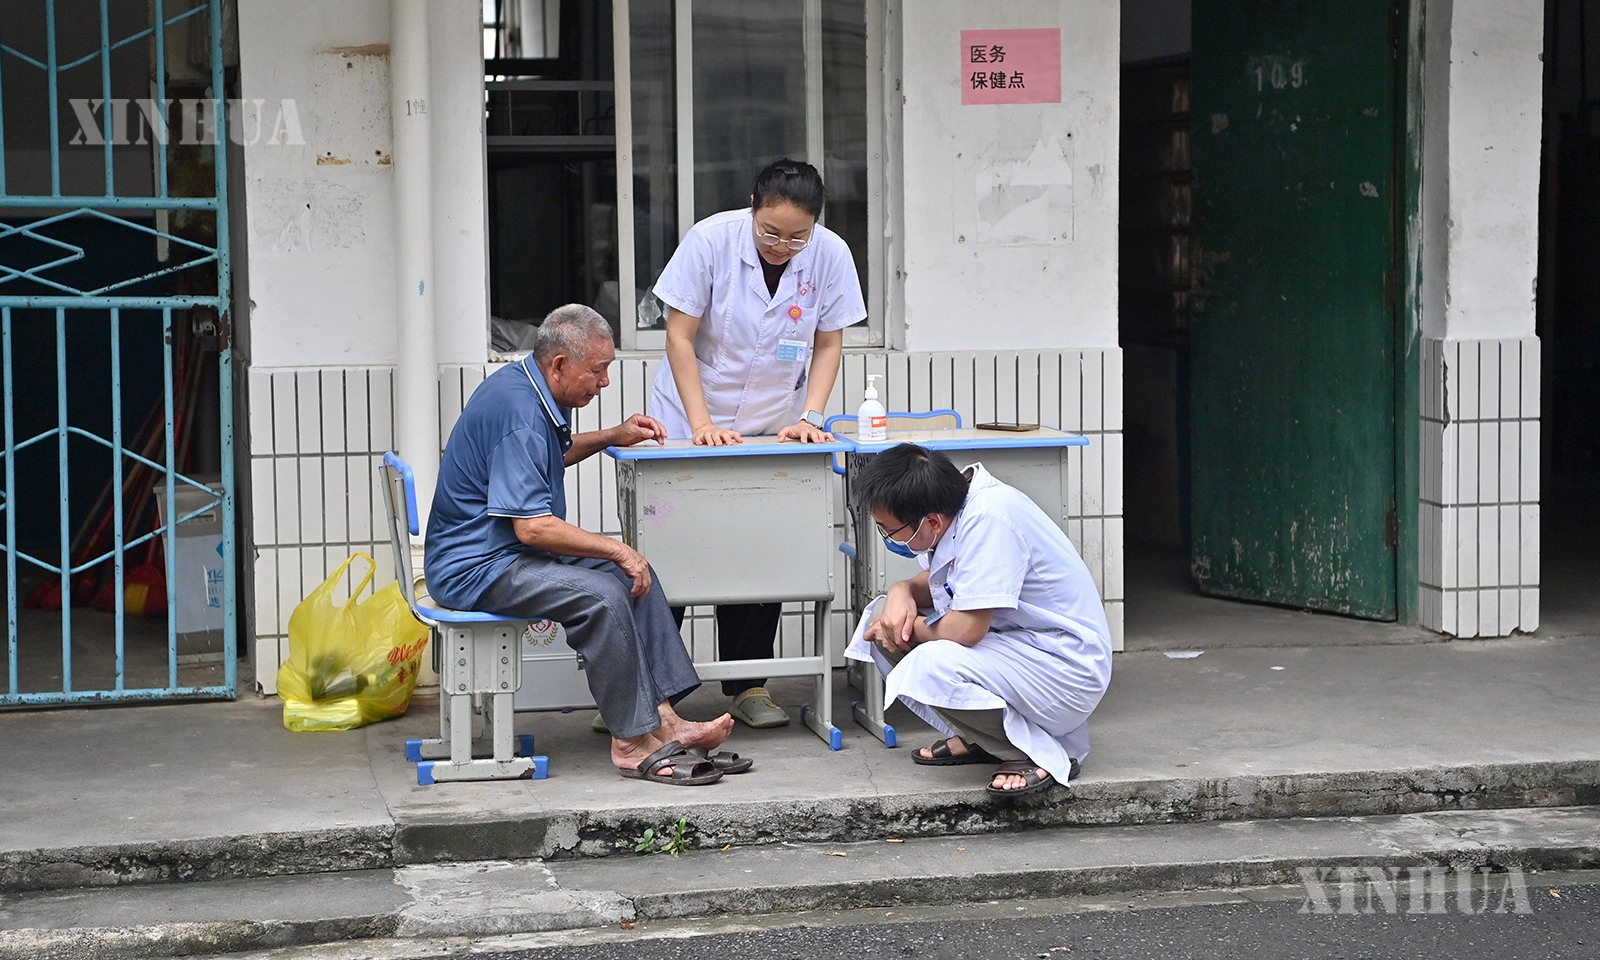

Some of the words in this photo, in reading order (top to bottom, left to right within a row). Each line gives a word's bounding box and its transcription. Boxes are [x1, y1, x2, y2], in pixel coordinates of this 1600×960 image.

[970, 44, 1007, 63] 医务
[970, 70, 1026, 90] 保健点
[1254, 61, 1303, 92] 109
